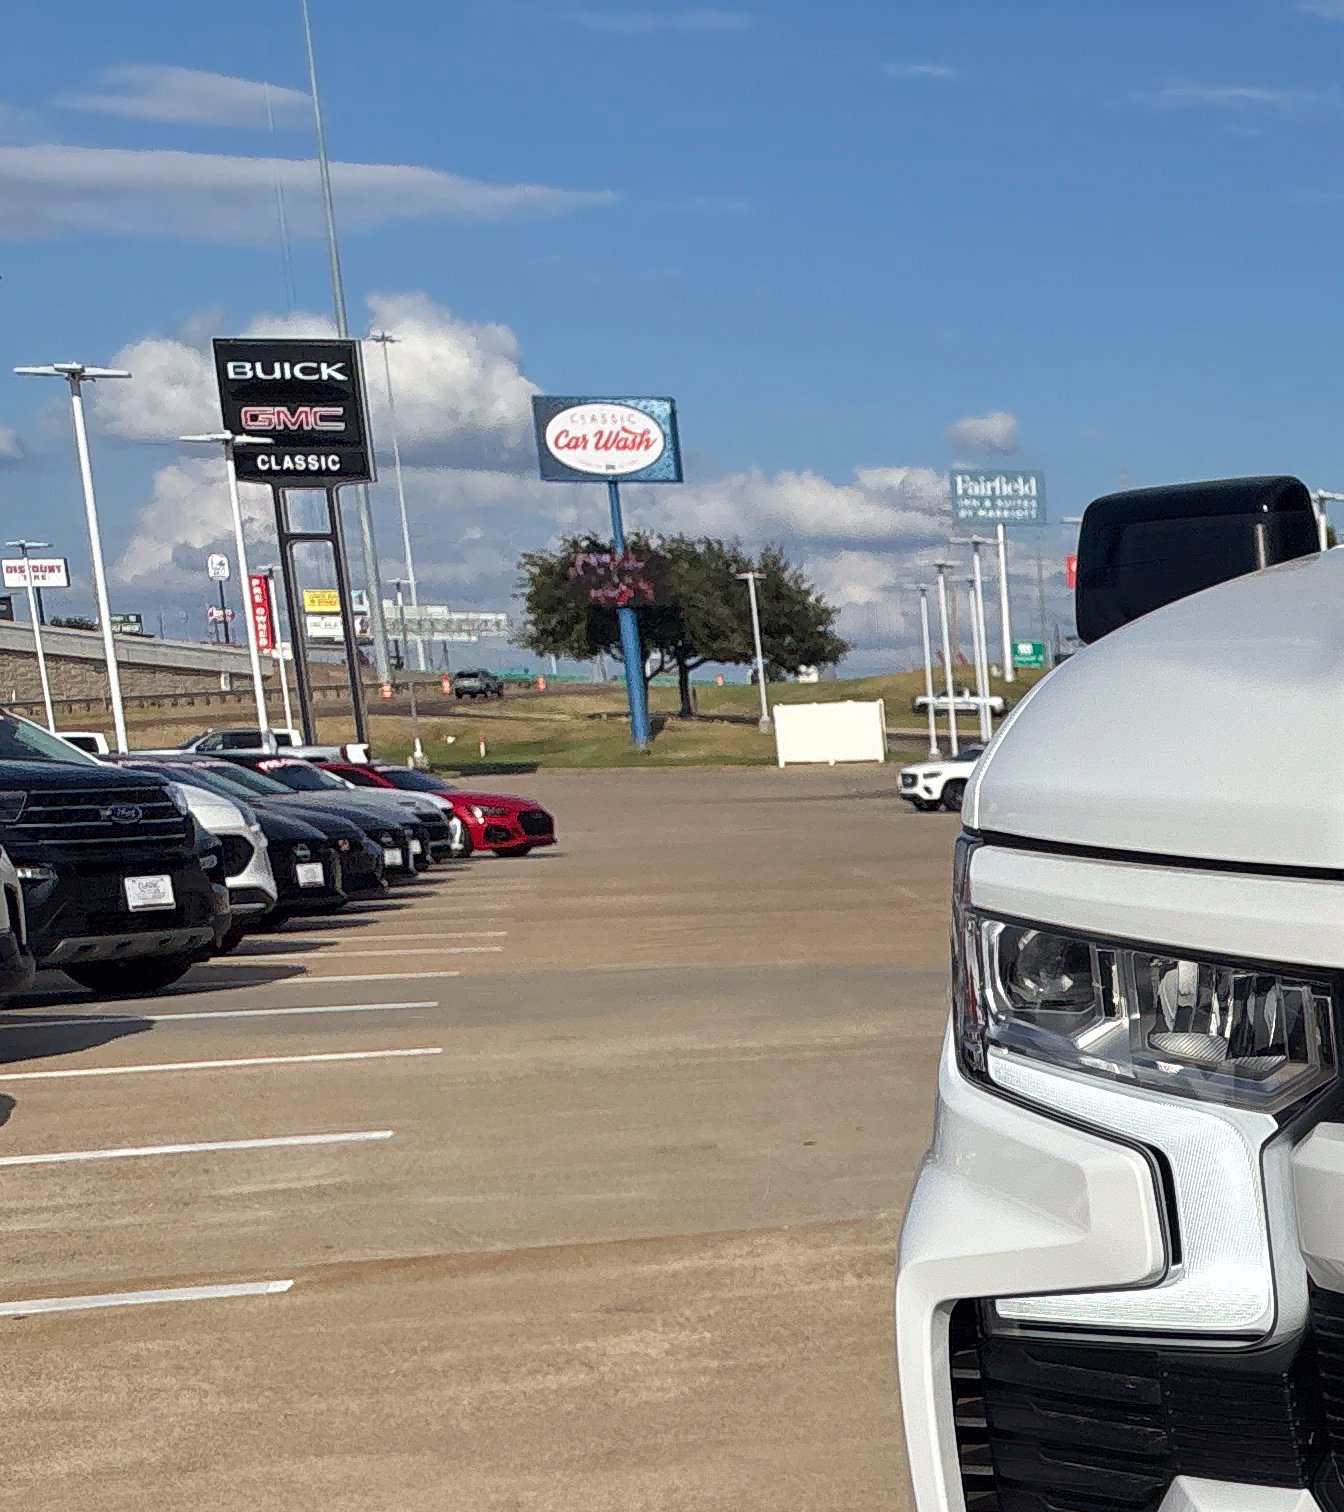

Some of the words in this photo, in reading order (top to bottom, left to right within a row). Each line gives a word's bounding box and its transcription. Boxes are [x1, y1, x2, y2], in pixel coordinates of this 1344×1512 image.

[226, 361, 349, 381] BUICK
[240, 406, 346, 431] GMC
[569, 412, 637, 425] CLASSIC
[553, 428, 590, 450] Car
[593, 425, 657, 451] Wash
[256, 454, 341, 471] CLASSIC
[955, 475, 1037, 496] Fairfield
